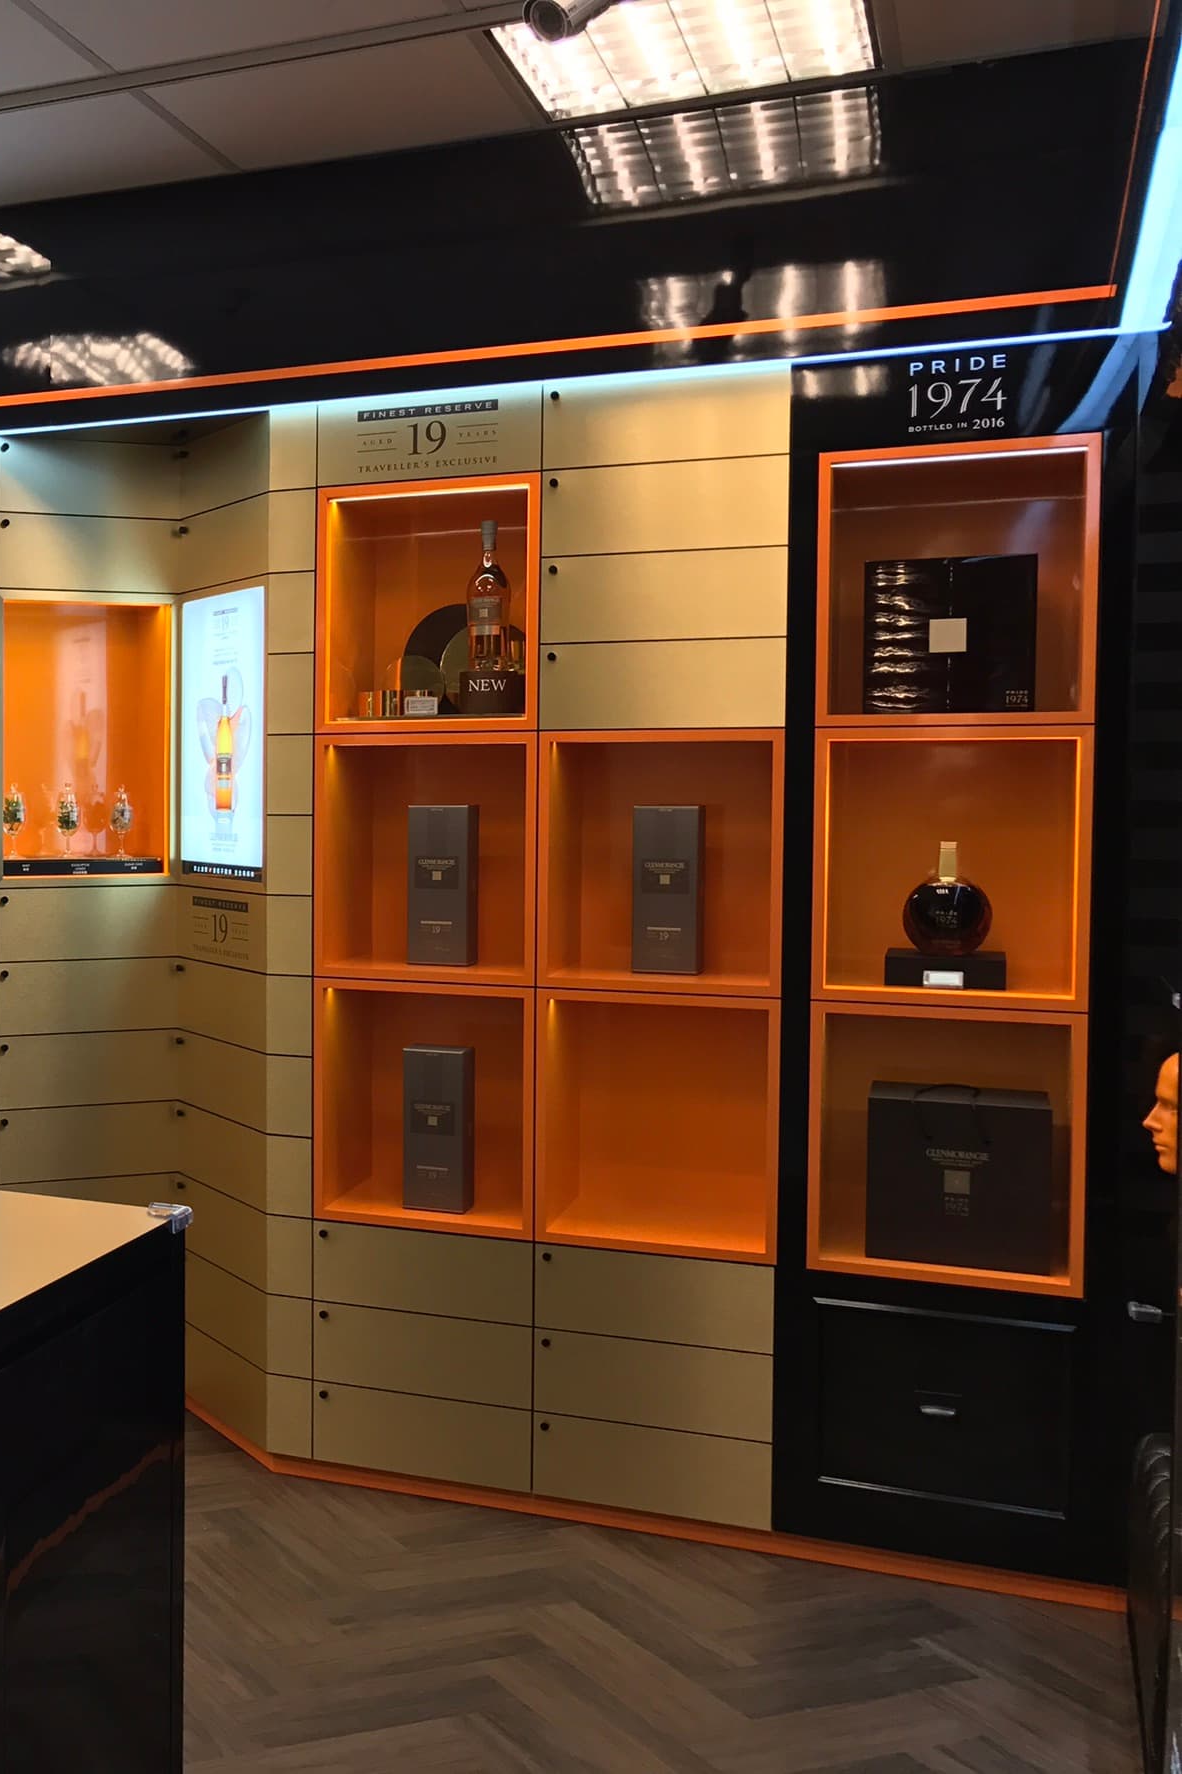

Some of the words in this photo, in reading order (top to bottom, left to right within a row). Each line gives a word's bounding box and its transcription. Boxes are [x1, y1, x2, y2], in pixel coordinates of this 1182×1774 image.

[909, 354, 1007, 377] PRIDE
[908, 377, 1007, 419] 1974
[363, 408, 416, 420] FINEST
[424, 400, 493, 414] RESERVE
[908, 423, 953, 433] BOTTLED
[972, 417, 1005, 429] 2016
[362, 438, 393, 446] AGED
[406, 420, 447, 456] 19
[358, 460, 429, 473] TRAVELLER'S
[436, 456, 498, 468] EXCLUSIVE
[468, 679, 506, 692] NEW
[1005, 695, 1028, 704] 1974
[211, 914, 228, 943] 19
